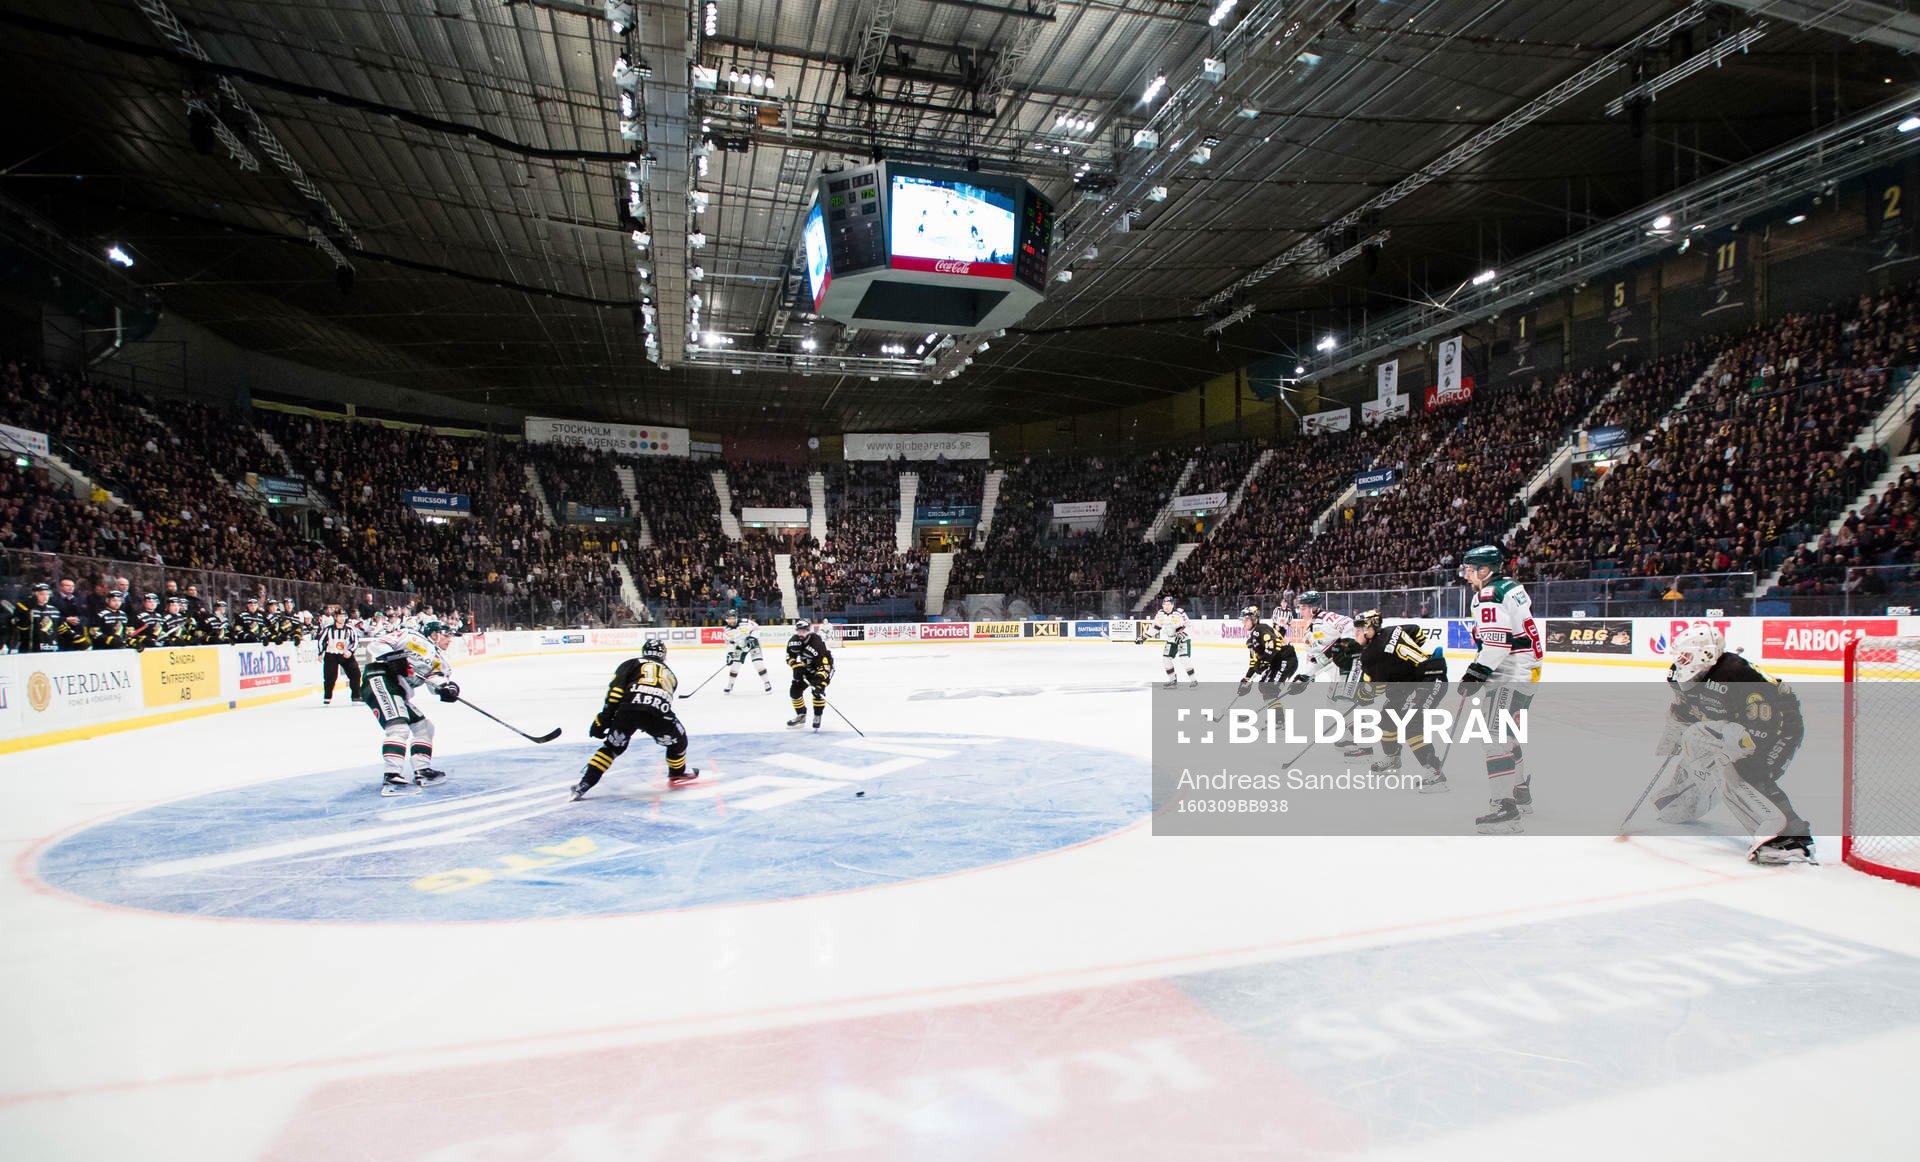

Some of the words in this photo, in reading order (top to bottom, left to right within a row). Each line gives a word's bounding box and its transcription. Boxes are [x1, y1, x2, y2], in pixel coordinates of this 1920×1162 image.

[1884, 185, 1901, 220] 2
[1717, 240, 1736, 272] 11
[1614, 282, 1625, 307] 5
[1520, 315, 1526, 338] 1
[552, 423, 610, 437] STOCKHOLM
[552, 434, 585, 447] GLOBE
[587, 438, 626, 449] ARENAS
[867, 440, 971, 452] www.globearenas.se
[411, 496, 447, 505] ERICSSON
[1481, 607, 1496, 623] 81
[921, 625, 968, 637] Prioritet
[1221, 623, 1250, 639] SHAMROC
[1569, 629, 1609, 641] RBG
[170, 651, 195, 666] SANDRA
[53, 670, 132, 695] VERDANA
[161, 671, 205, 685] ENTREPRENAD
[180, 687, 191, 700] AB
[1745, 702, 1772, 721] 30
[412, 835, 599, 896] ATG
